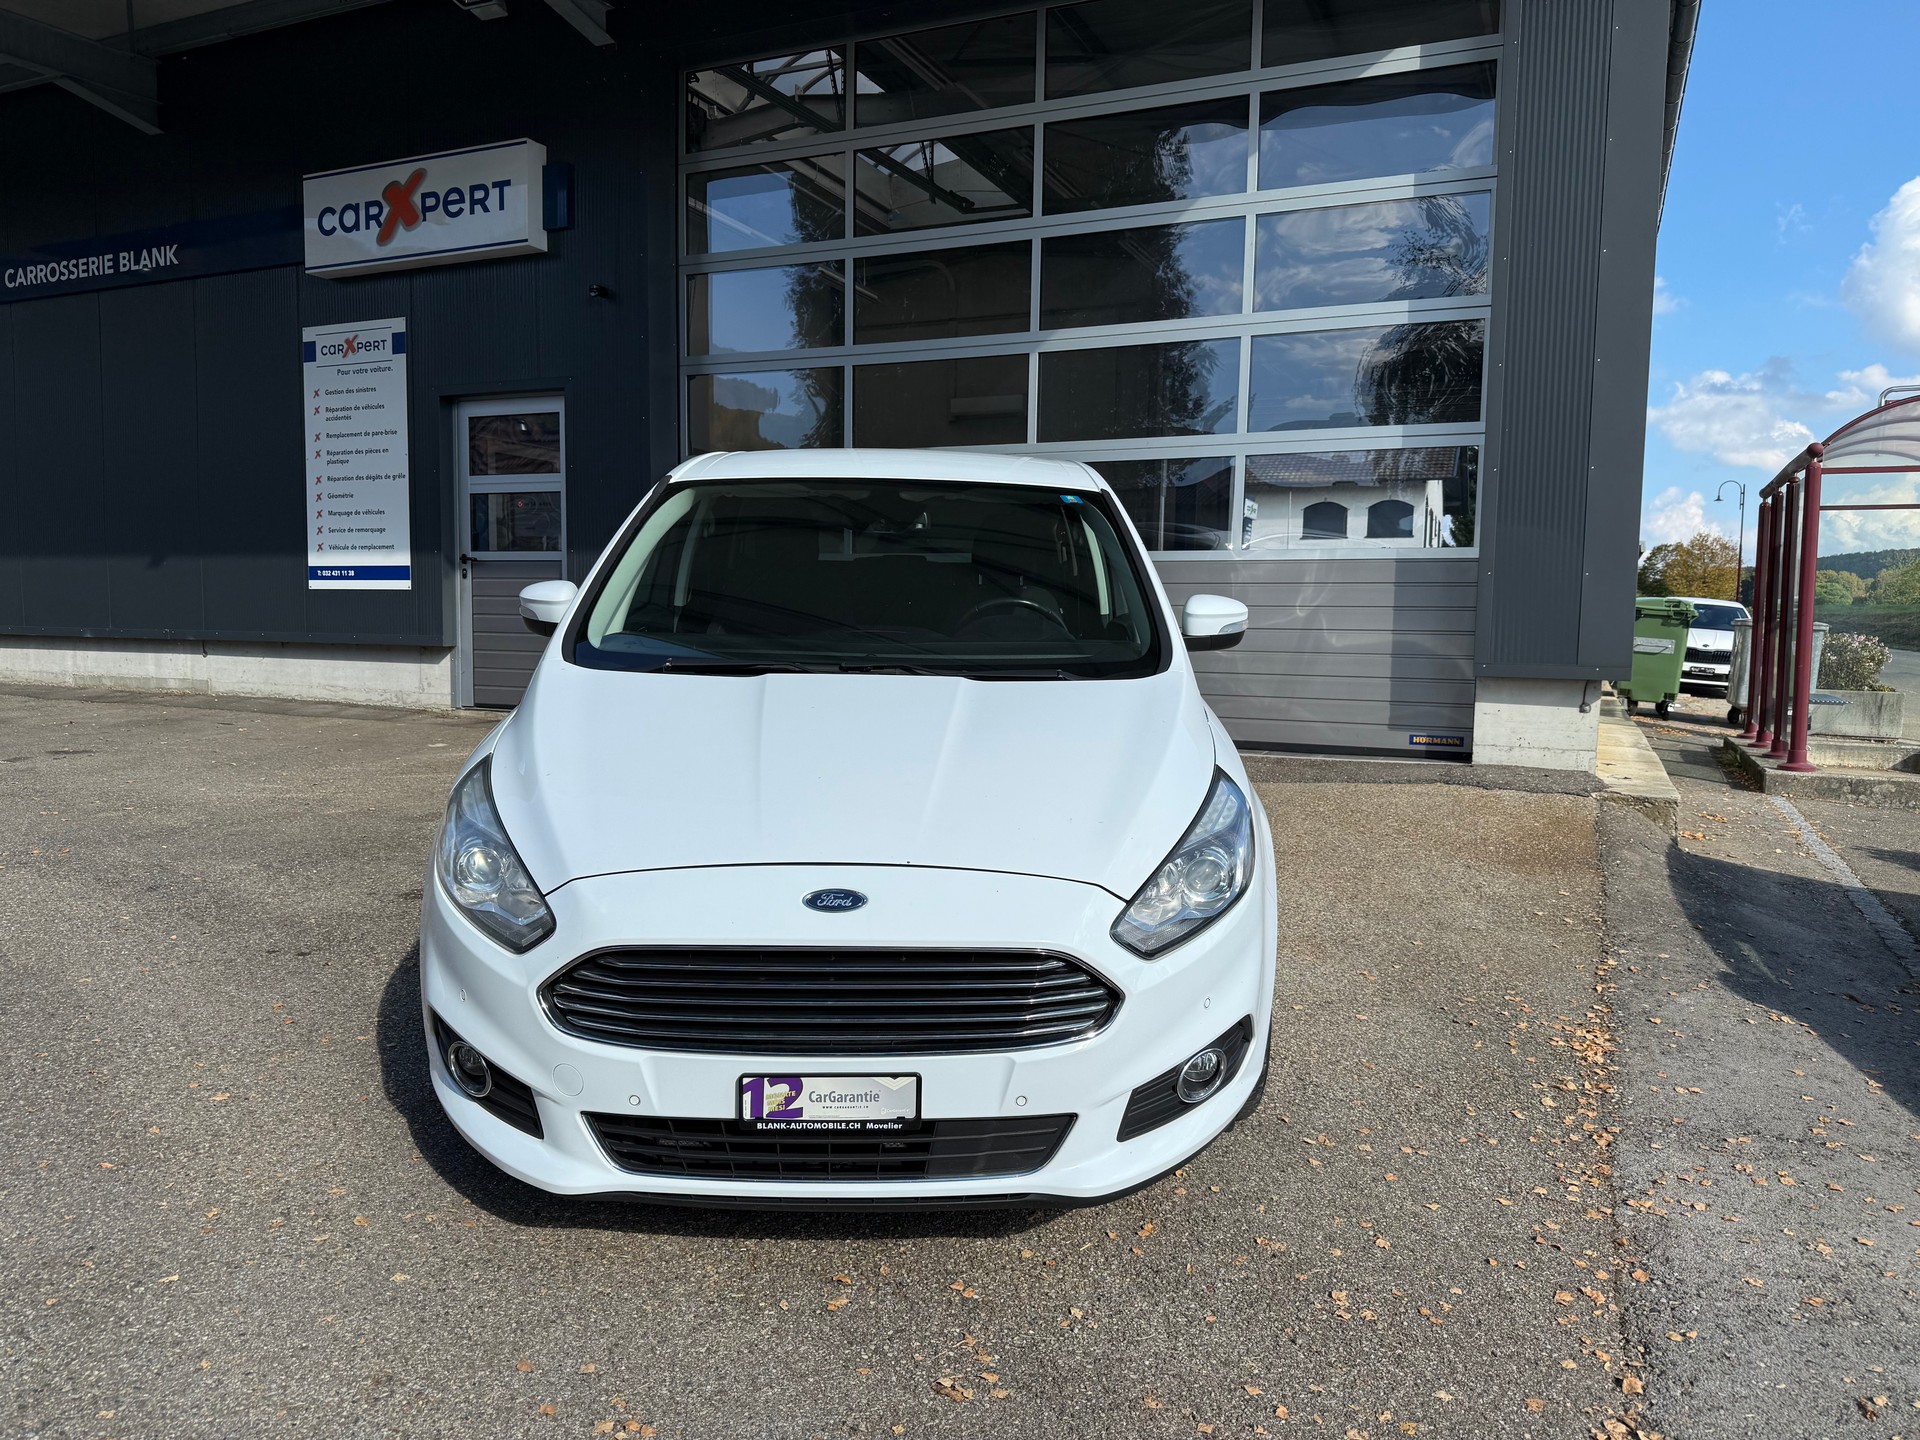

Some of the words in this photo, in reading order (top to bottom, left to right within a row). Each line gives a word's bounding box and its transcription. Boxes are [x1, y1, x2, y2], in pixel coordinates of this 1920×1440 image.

[4, 253, 114, 288] CARROSSERIE
[119, 244, 179, 273] BLANK
[336, 368, 351, 376] Pour
[352, 367, 369, 375] votre
[370, 365, 393, 373] voiture.
[324, 388, 345, 396] Gestion
[325, 405, 353, 414] Réparation
[361, 402, 385, 411] véhicules
[325, 413, 352, 422] accidentés
[326, 431, 363, 440] Remplacement
[371, 428, 398, 438] pare-brise
[326, 448, 354, 457] Réparation
[354, 447, 364, 455] des
[364, 447, 381, 455] pièces
[326, 458, 350, 466] plastique
[327, 474, 354, 483] Réparation
[354, 473, 365, 481] des
[365, 472, 383, 482] dégâts
[384, 472, 391, 480] de
[392, 472, 406, 481] grêle
[327, 491, 354, 500] Géométrie
[327, 509, 353, 518] Marquage
[354, 508, 361, 516] de
[361, 508, 386, 516] véhicules
[327, 526, 346, 534] Service
[354, 526, 386, 535] remorquage
[328, 543, 350, 551] Véhicule
[357, 543, 395, 552] remplacement
[331, 569, 341, 577] 431
[341, 569, 348, 577] 11
[816, 893, 853, 906] Ford
[743, 1077, 804, 1119] 12
[808, 1090, 881, 1104] CarGarantie
[756, 1121, 861, 1130] BLANK-AUTOMOBILE.CH
[865, 1121, 903, 1130] Movelier
